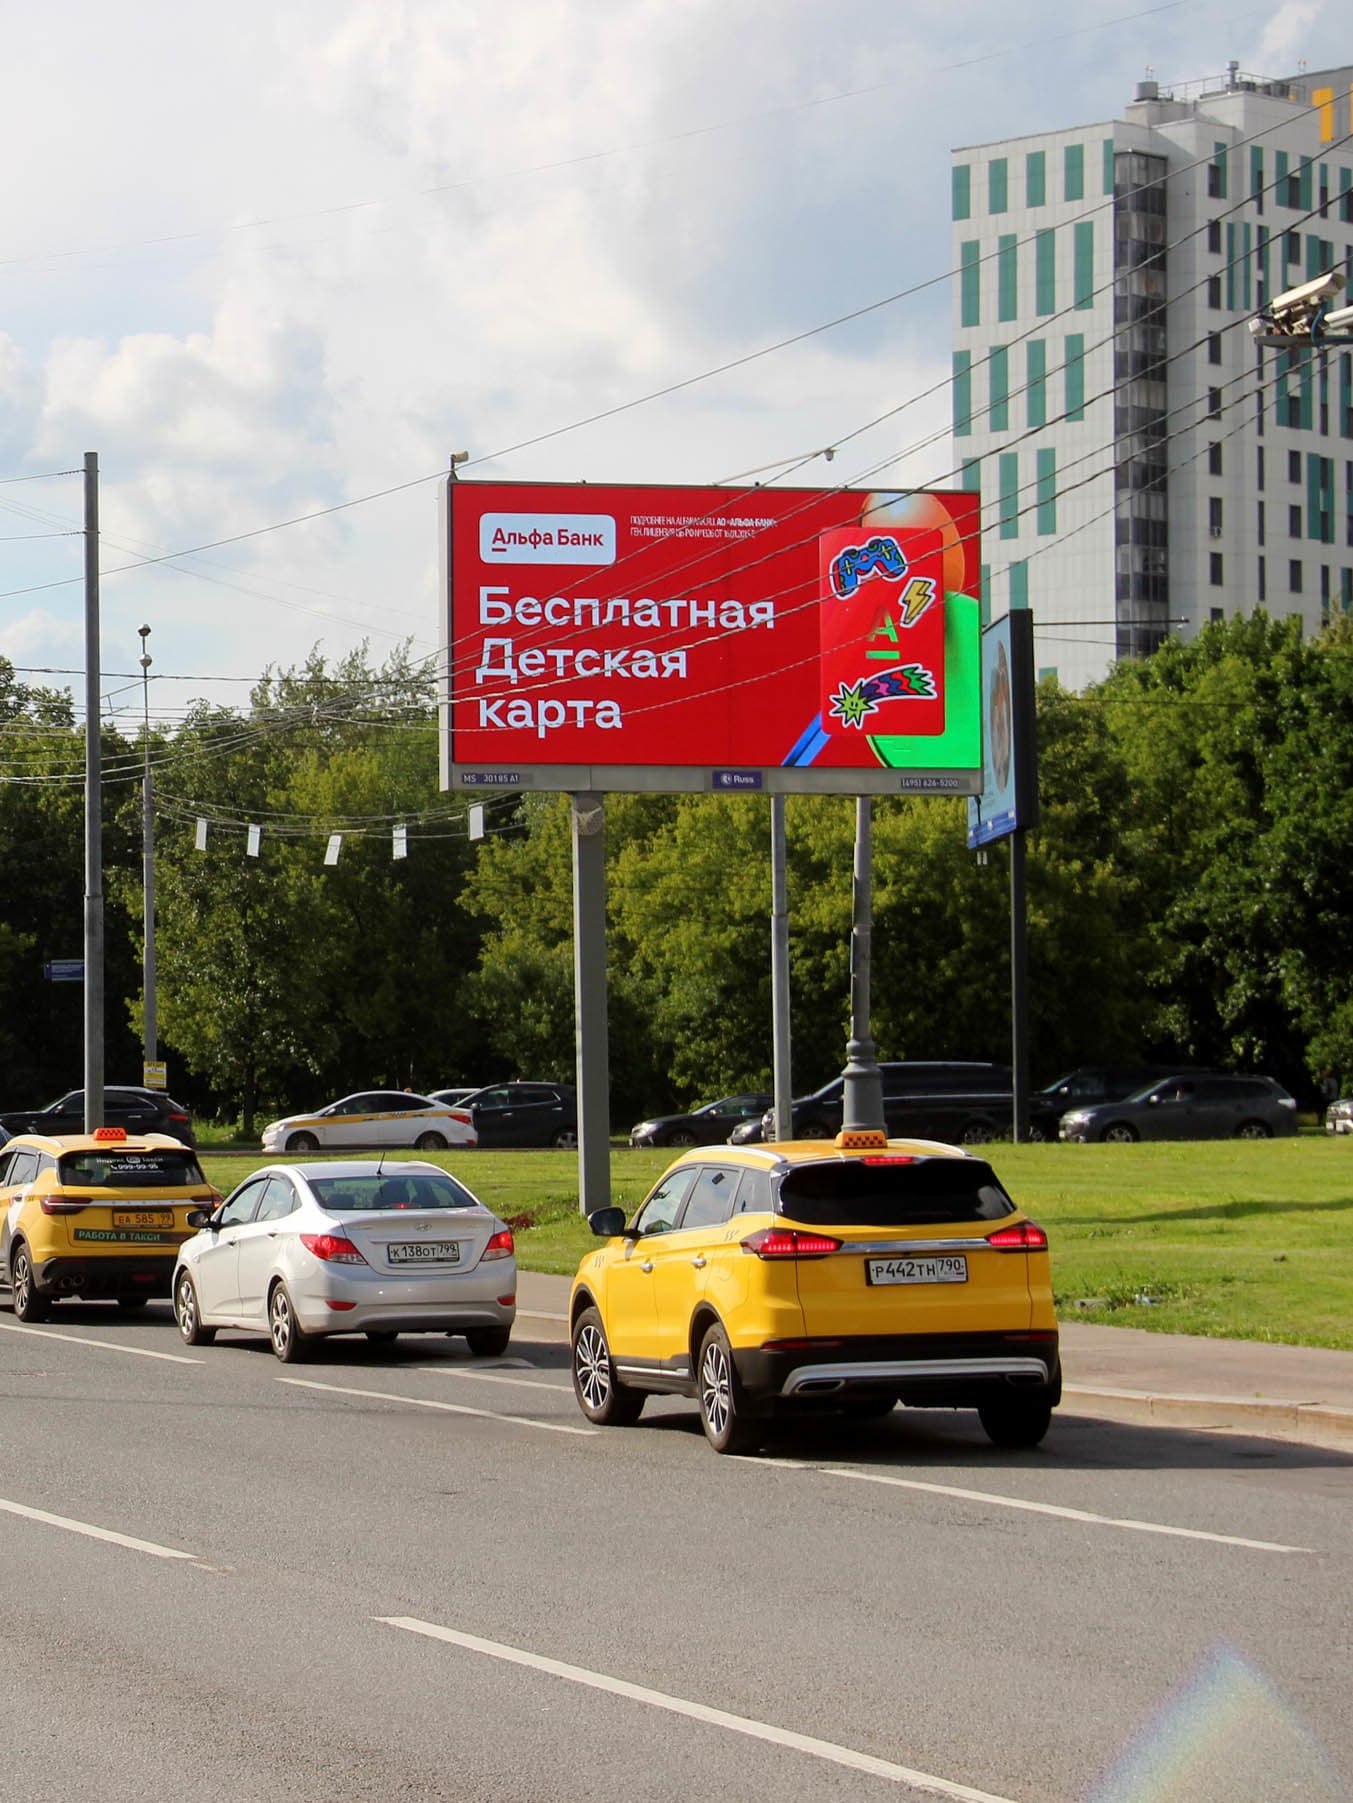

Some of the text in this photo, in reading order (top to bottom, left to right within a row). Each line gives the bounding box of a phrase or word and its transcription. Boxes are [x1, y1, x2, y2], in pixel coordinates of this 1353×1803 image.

[492, 528, 604, 552] Альфа Банк
[479, 586, 775, 629] Бесплатная
[475, 638, 687, 684] Детская
[479, 699, 622, 738] карта
[136, 1214, 154, 1224] 585
[79, 1231, 160, 1241] РАБОТА В ТАКСИ
[393, 1246, 437, 1257] К138ОТ
[875, 1259, 961, 1278] Р442ТН 790
